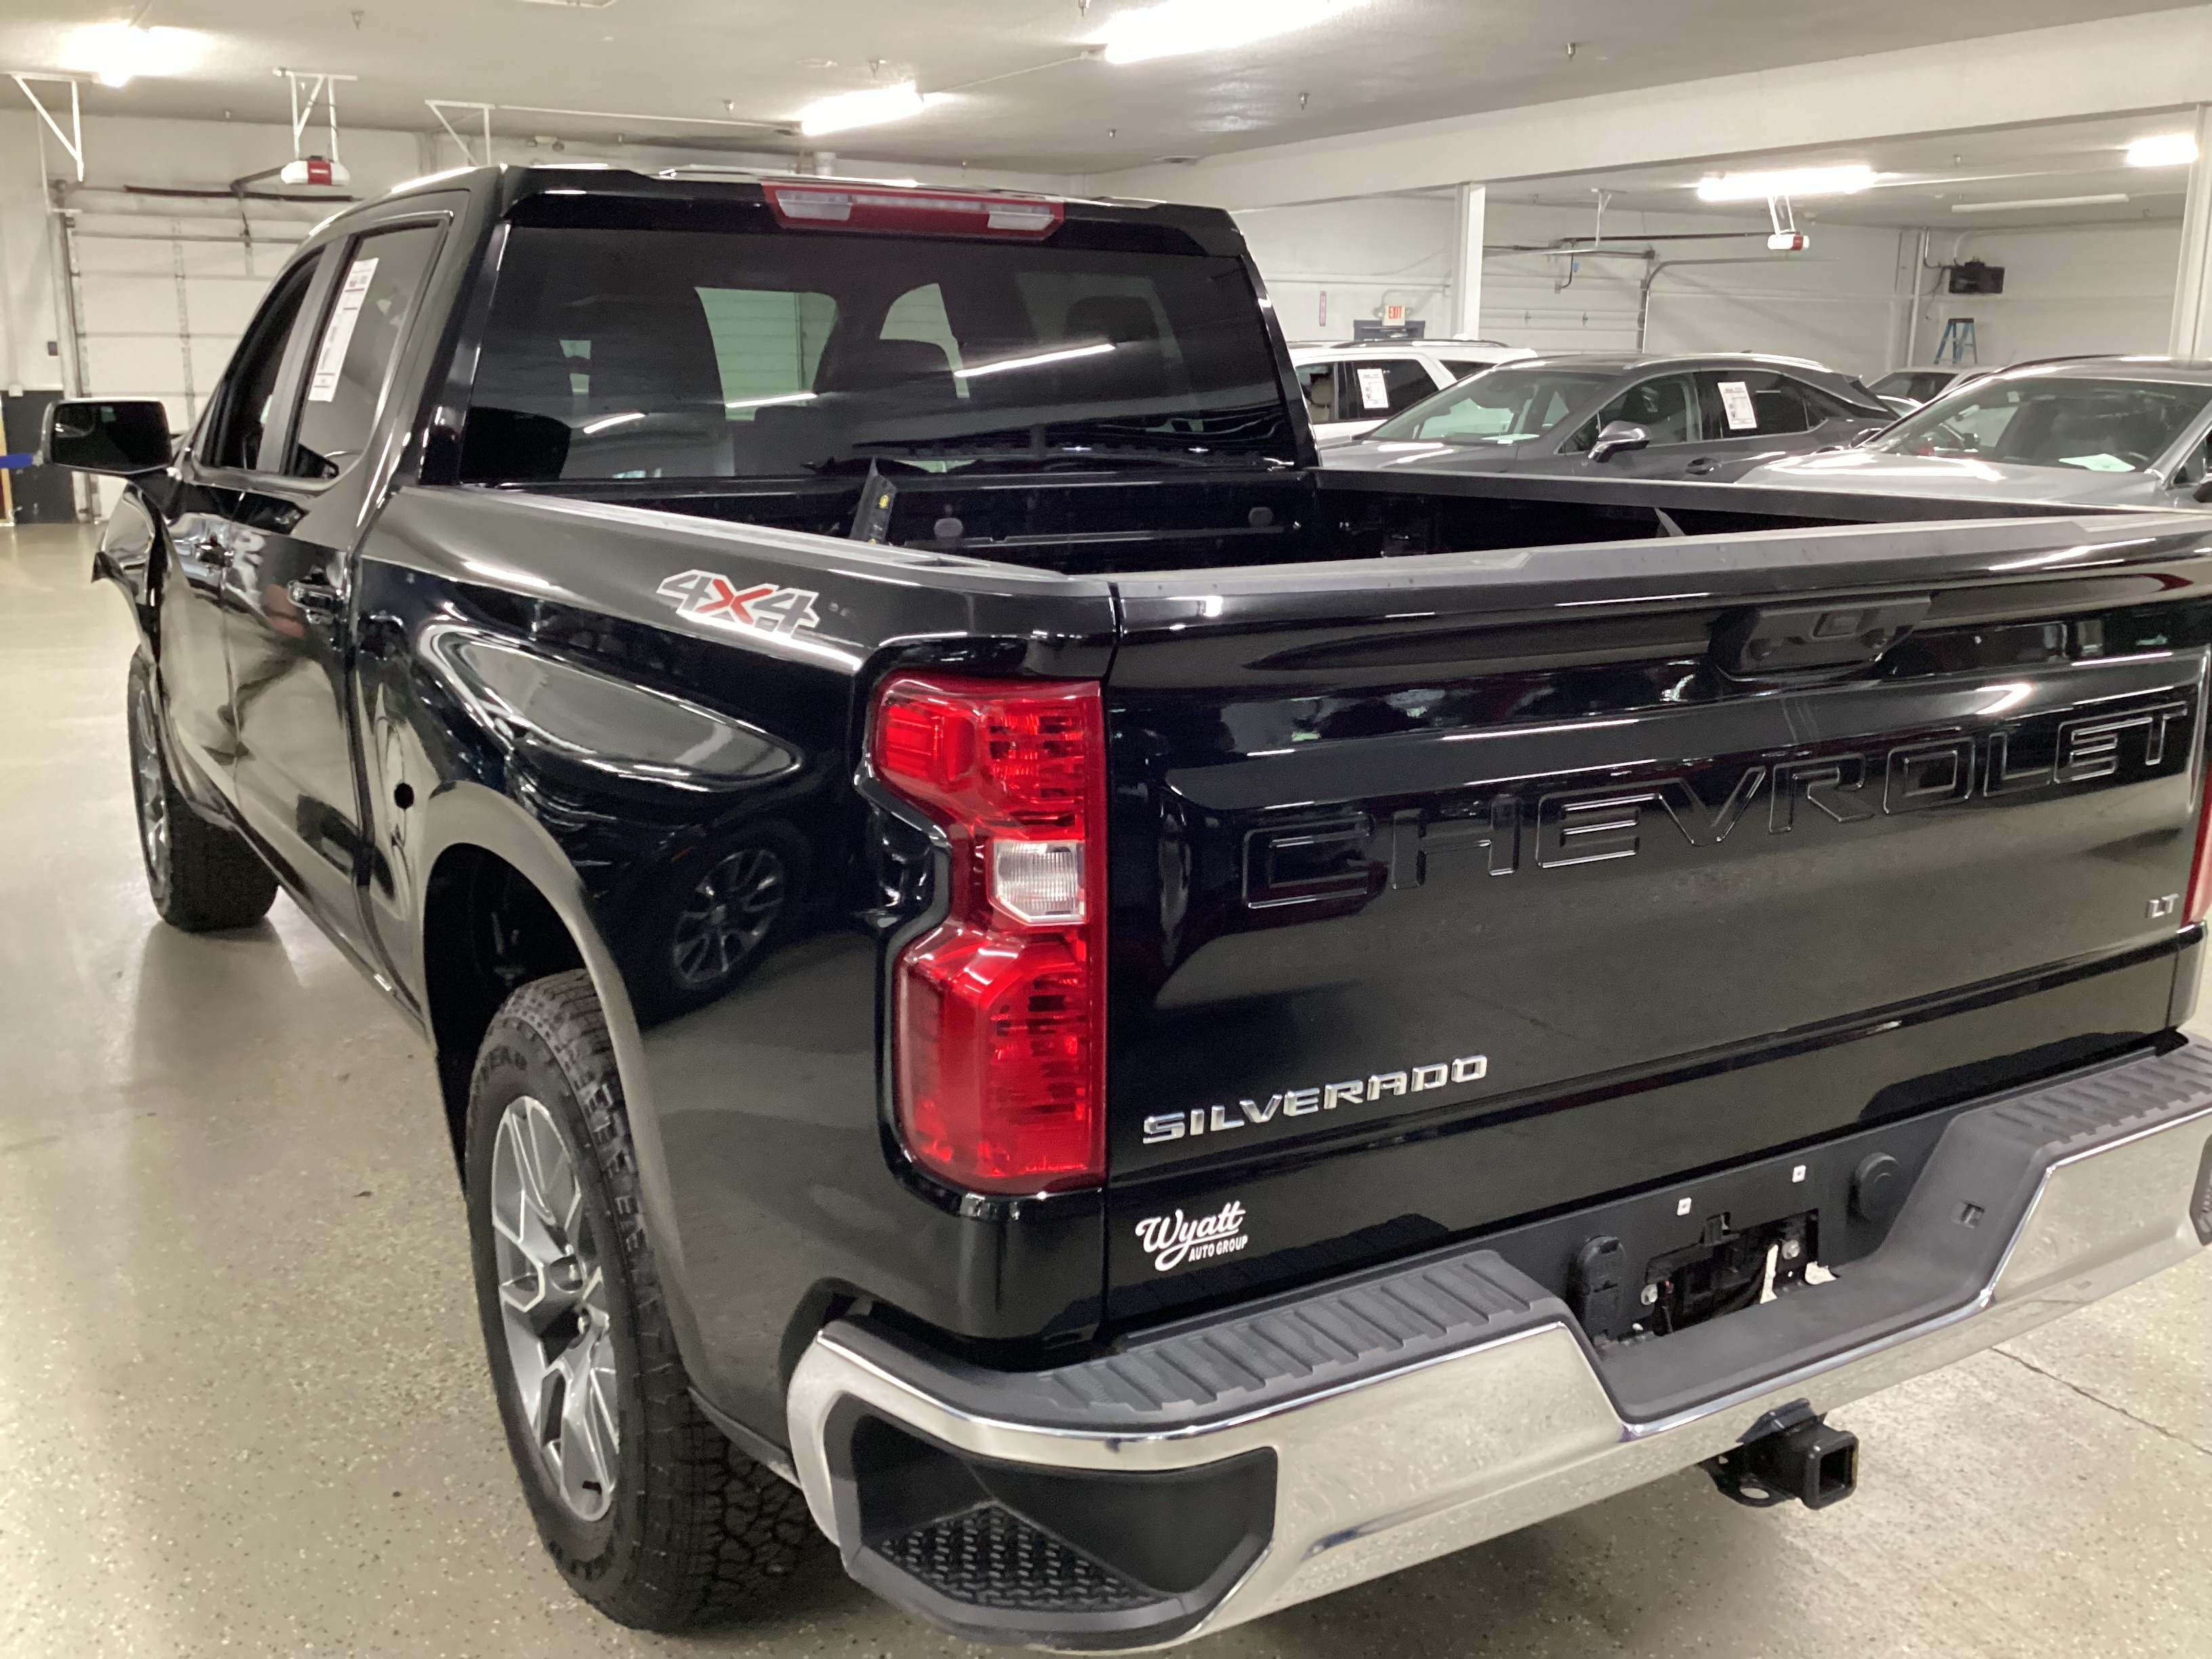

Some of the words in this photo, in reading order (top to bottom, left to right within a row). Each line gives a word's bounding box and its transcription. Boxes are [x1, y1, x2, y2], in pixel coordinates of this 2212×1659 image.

[1388, 306, 1403, 319] EXIT
[1242, 700, 2189, 909] CHEVROLET
[2145, 893, 2180, 919] LT
[1143, 1054, 1488, 1144] SILVERADO
[1134, 1200, 1246, 1271] Wyatt
[1188, 1244, 1214, 1262] AUTO
[1216, 1234, 1248, 1255] GROUP
